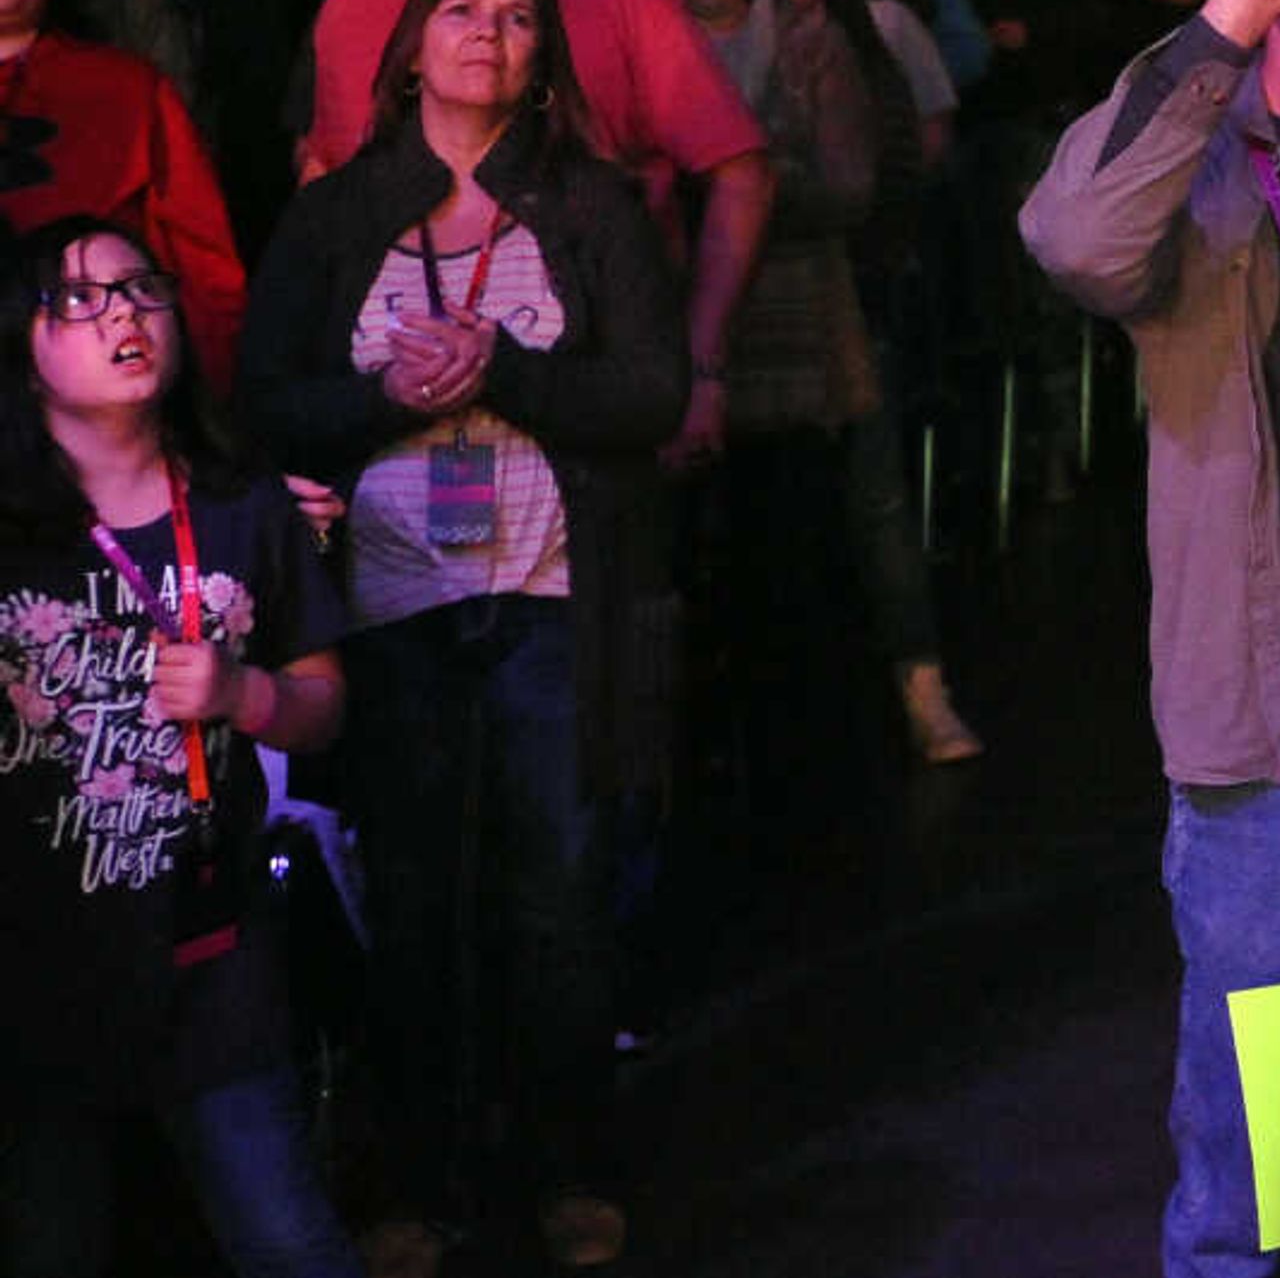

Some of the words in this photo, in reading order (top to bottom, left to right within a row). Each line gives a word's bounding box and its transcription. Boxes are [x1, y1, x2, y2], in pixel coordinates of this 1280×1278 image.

[157, 564, 179, 613] A
[40, 624, 157, 697] Child
[66, 688, 182, 780] True
